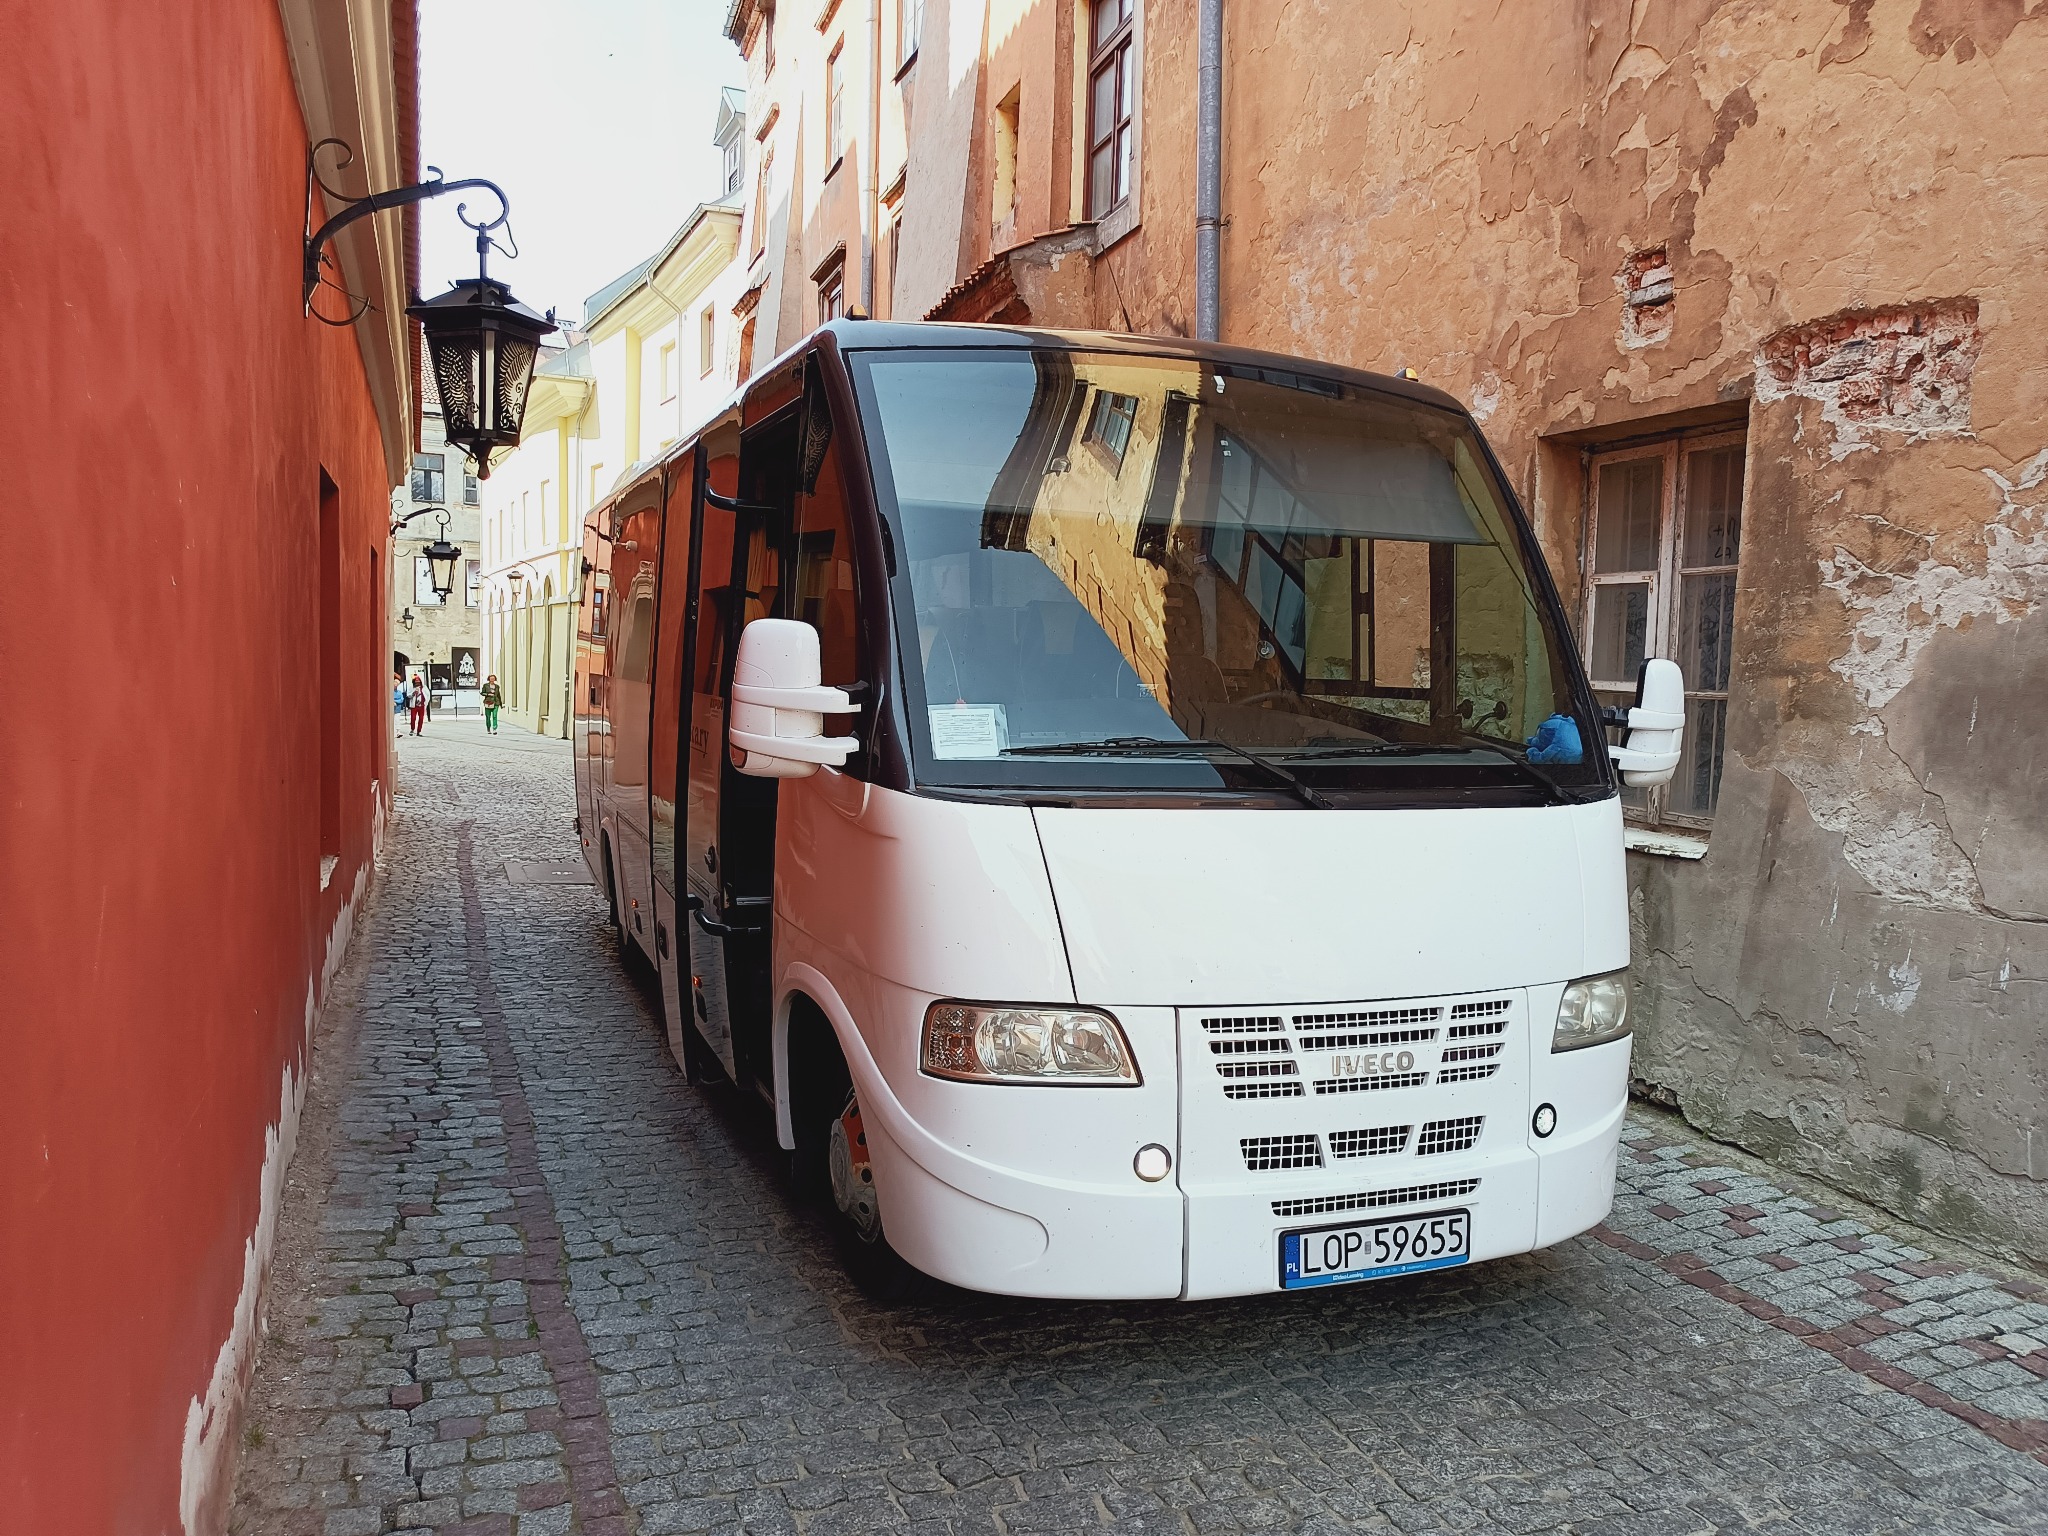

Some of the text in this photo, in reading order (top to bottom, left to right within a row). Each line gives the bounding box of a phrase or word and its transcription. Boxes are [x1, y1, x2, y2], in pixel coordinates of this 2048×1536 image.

[1332, 1051, 1414, 1076] IVECO
[1304, 1217, 1463, 1274] LOP 59655
[1286, 1263, 1299, 1273] PL
